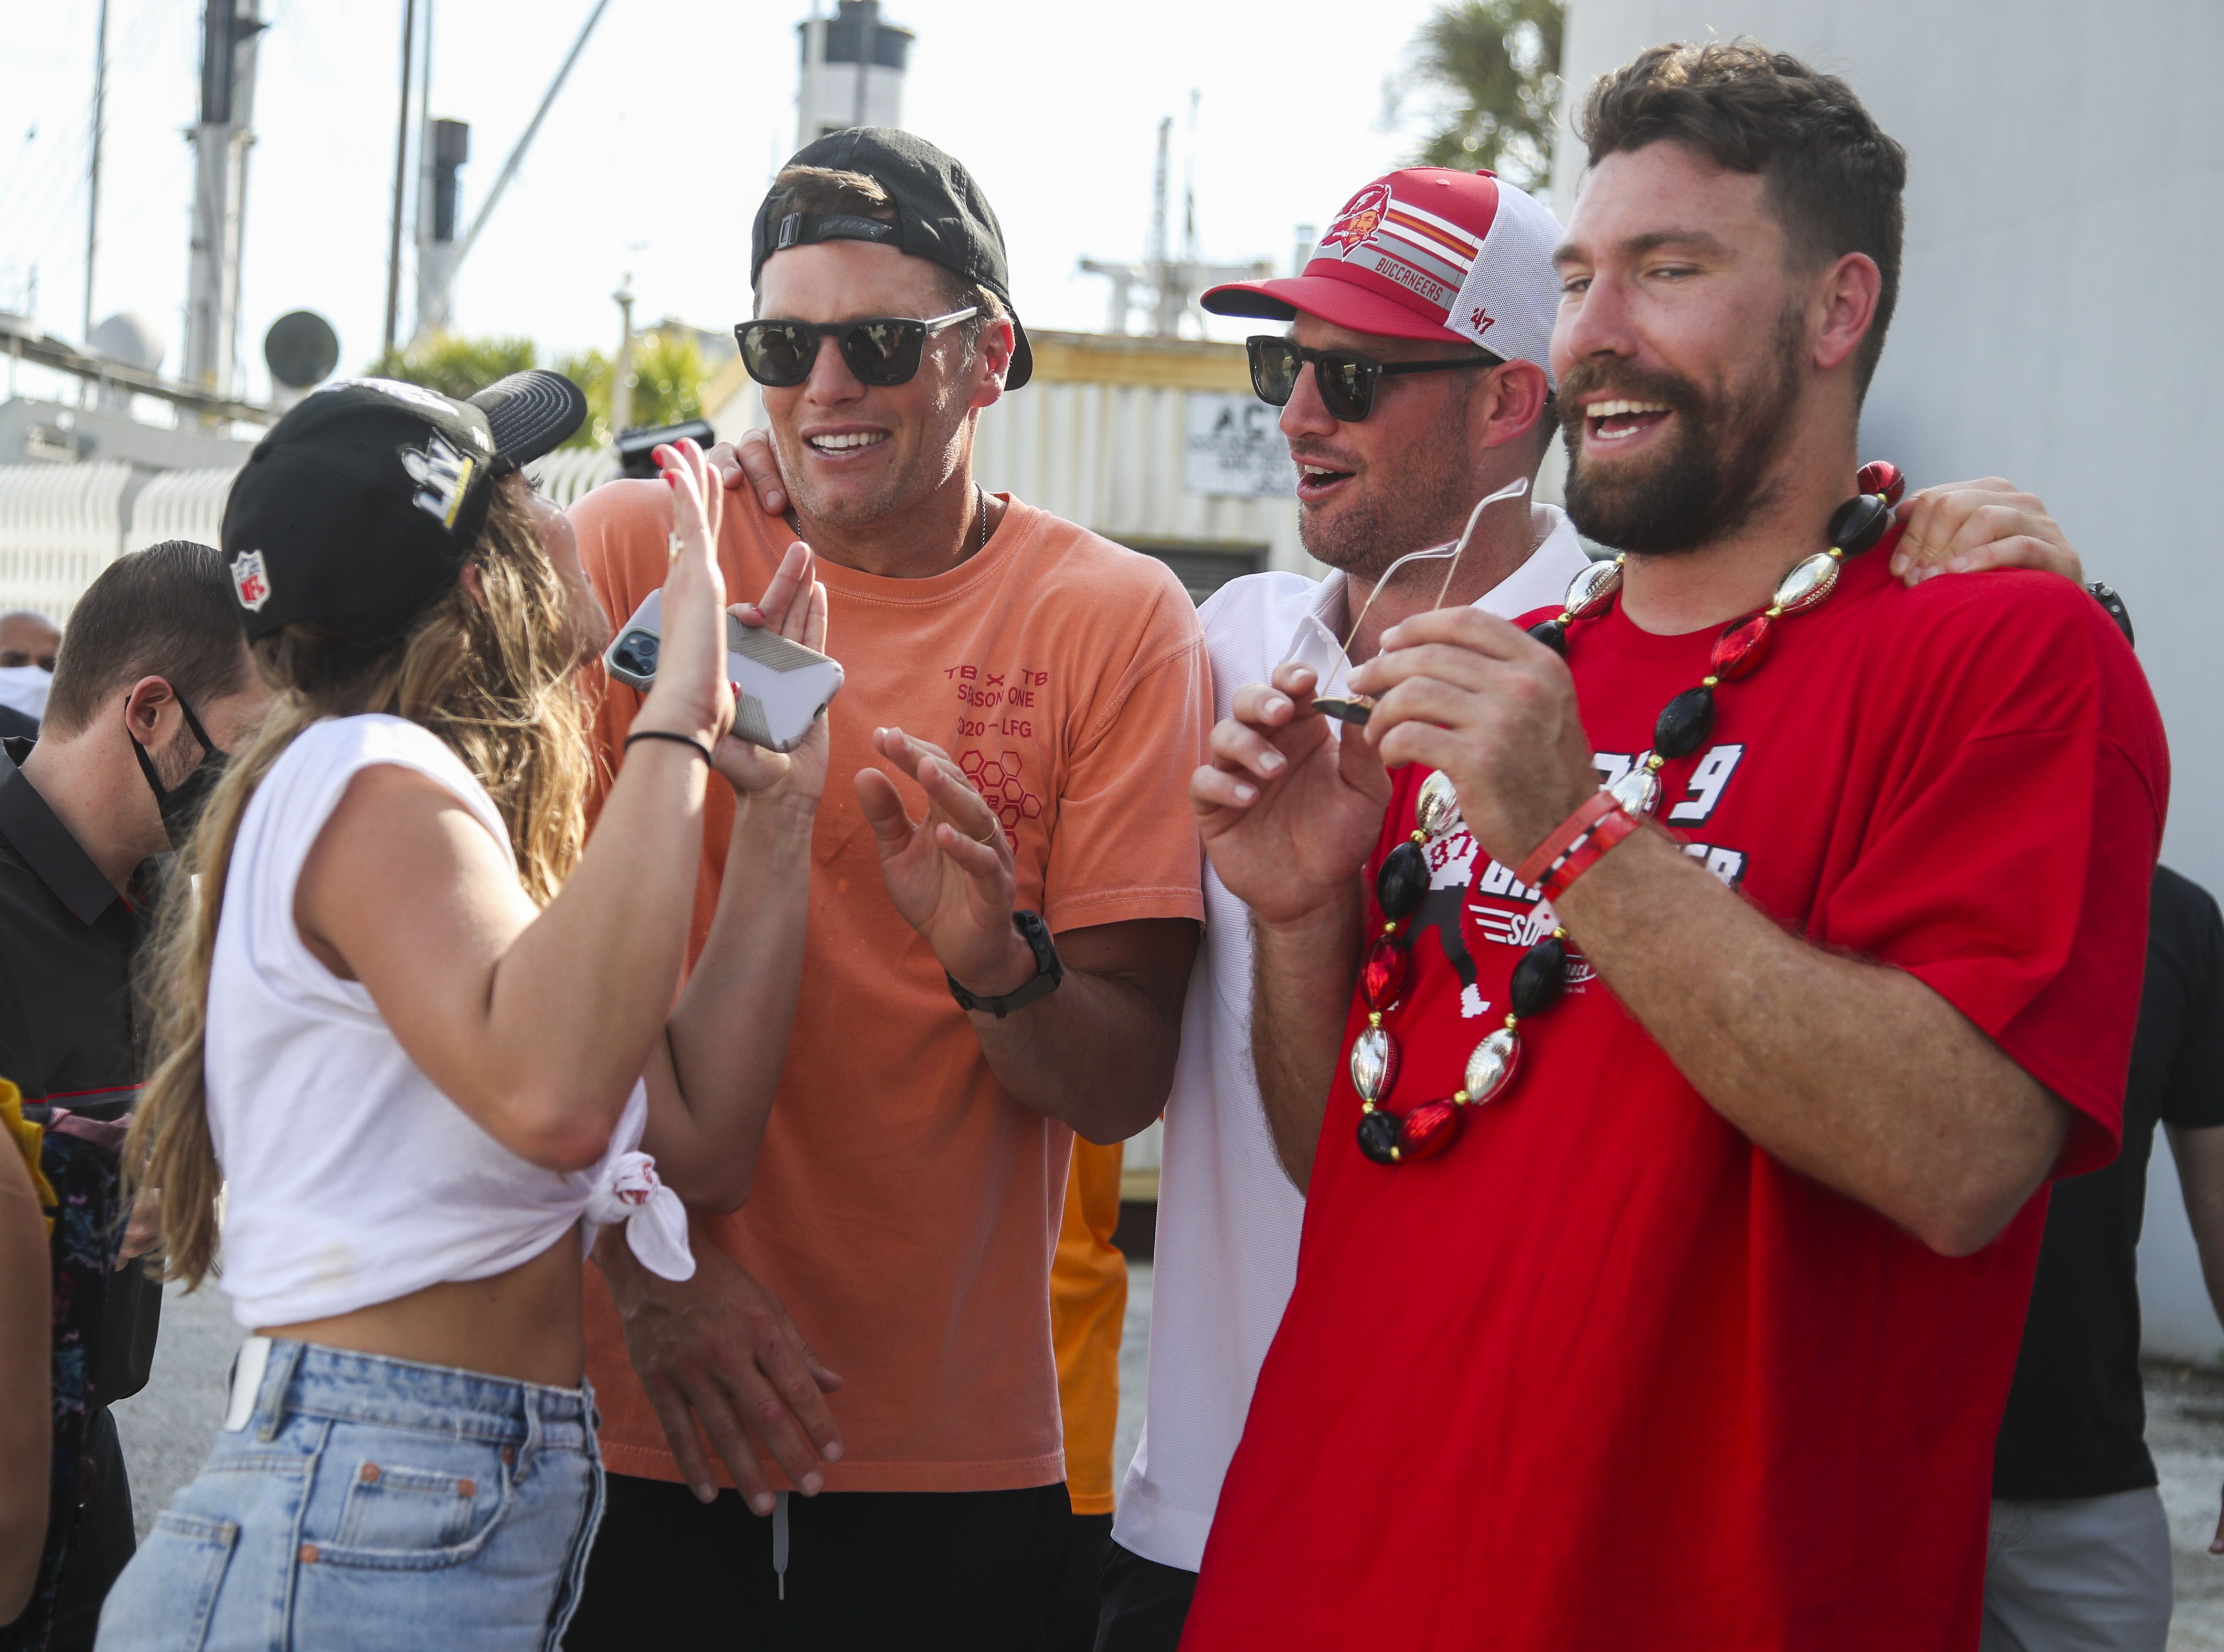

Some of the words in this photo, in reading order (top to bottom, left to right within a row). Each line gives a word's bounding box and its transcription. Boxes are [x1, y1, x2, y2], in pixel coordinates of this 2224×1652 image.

[1375, 257, 1443, 302] BUCCANEERS
[944, 665, 977, 680] TB
[1021, 669, 1048, 686] TB
[1008, 687, 1035, 708] ONE
[1002, 718, 1032, 738] LFG
